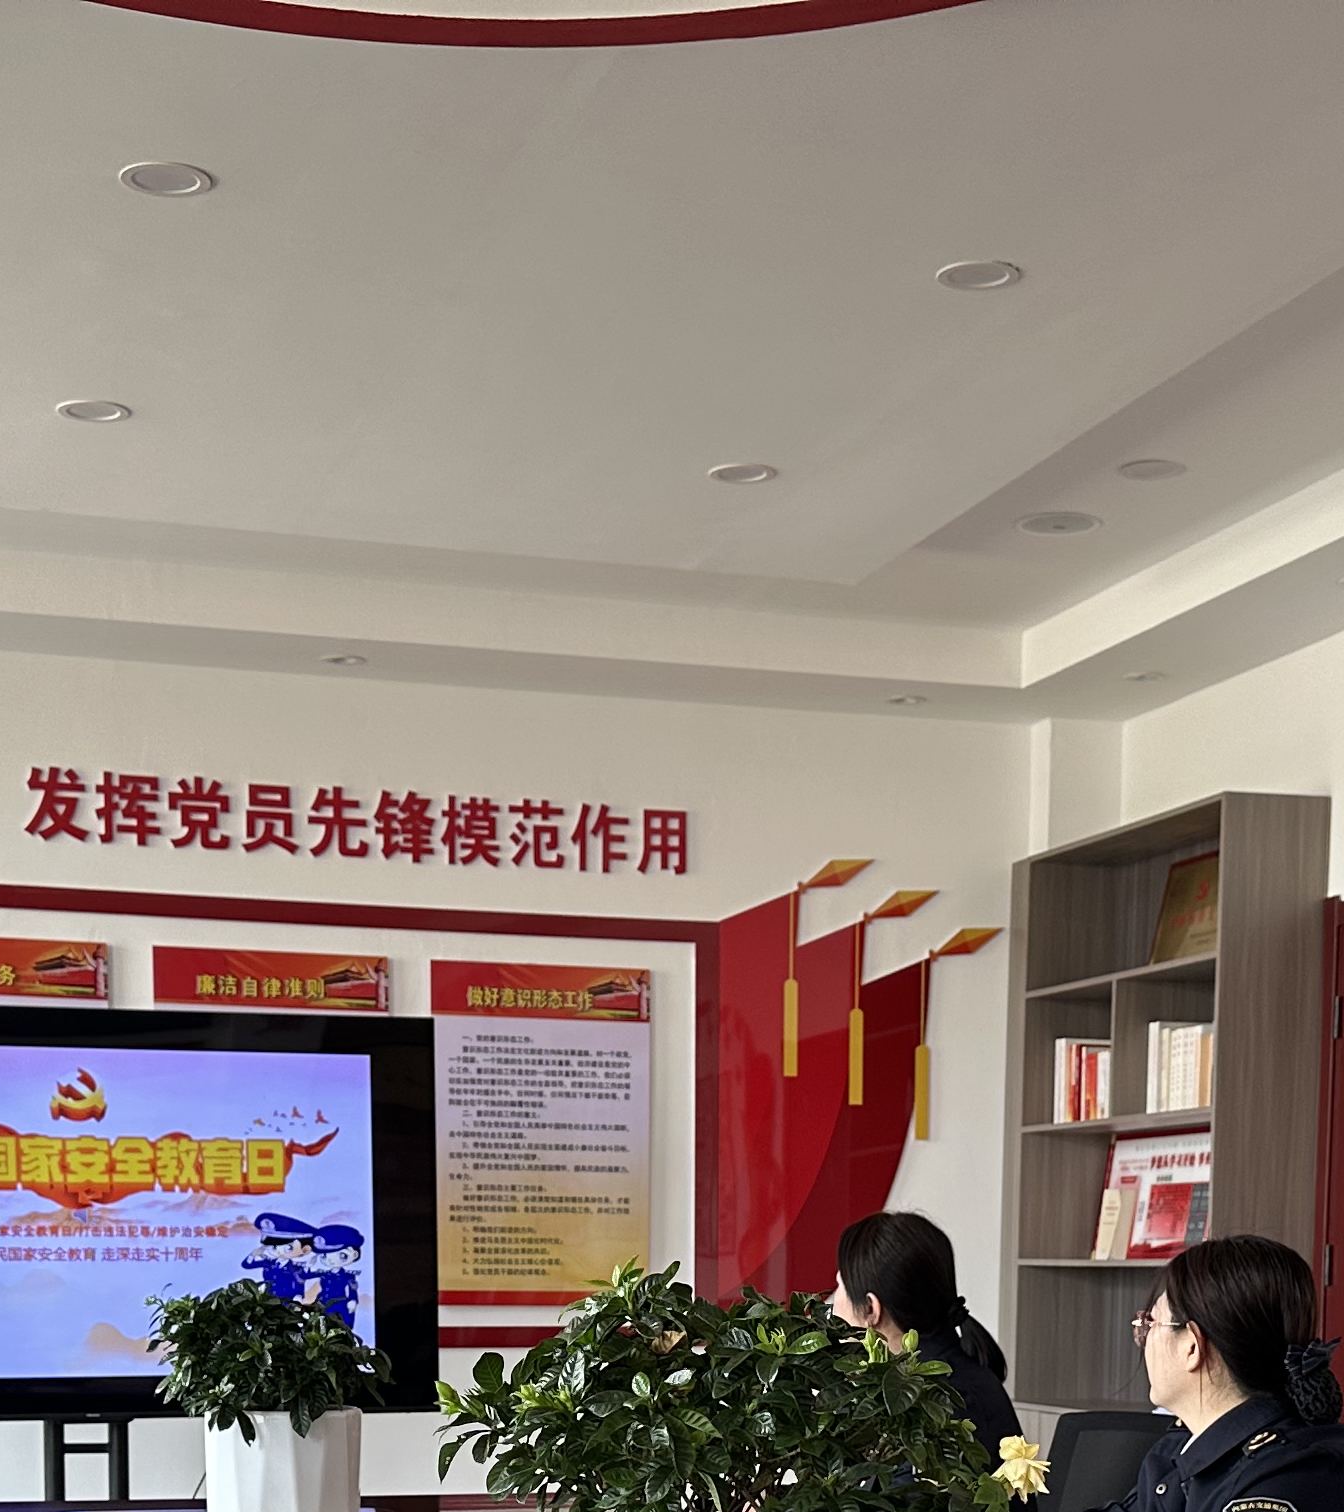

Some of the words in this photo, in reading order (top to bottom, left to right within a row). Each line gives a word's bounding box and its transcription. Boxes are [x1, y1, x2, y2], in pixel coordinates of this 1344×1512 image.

[25, 766, 689, 875] 发挥党员先锋模范作用
[194, 973, 326, 1001] 廉洁自律准则
[466, 986, 594, 1012] 做好意识形态工作
[101, 1246, 204, 1263] 走深走实十周年
